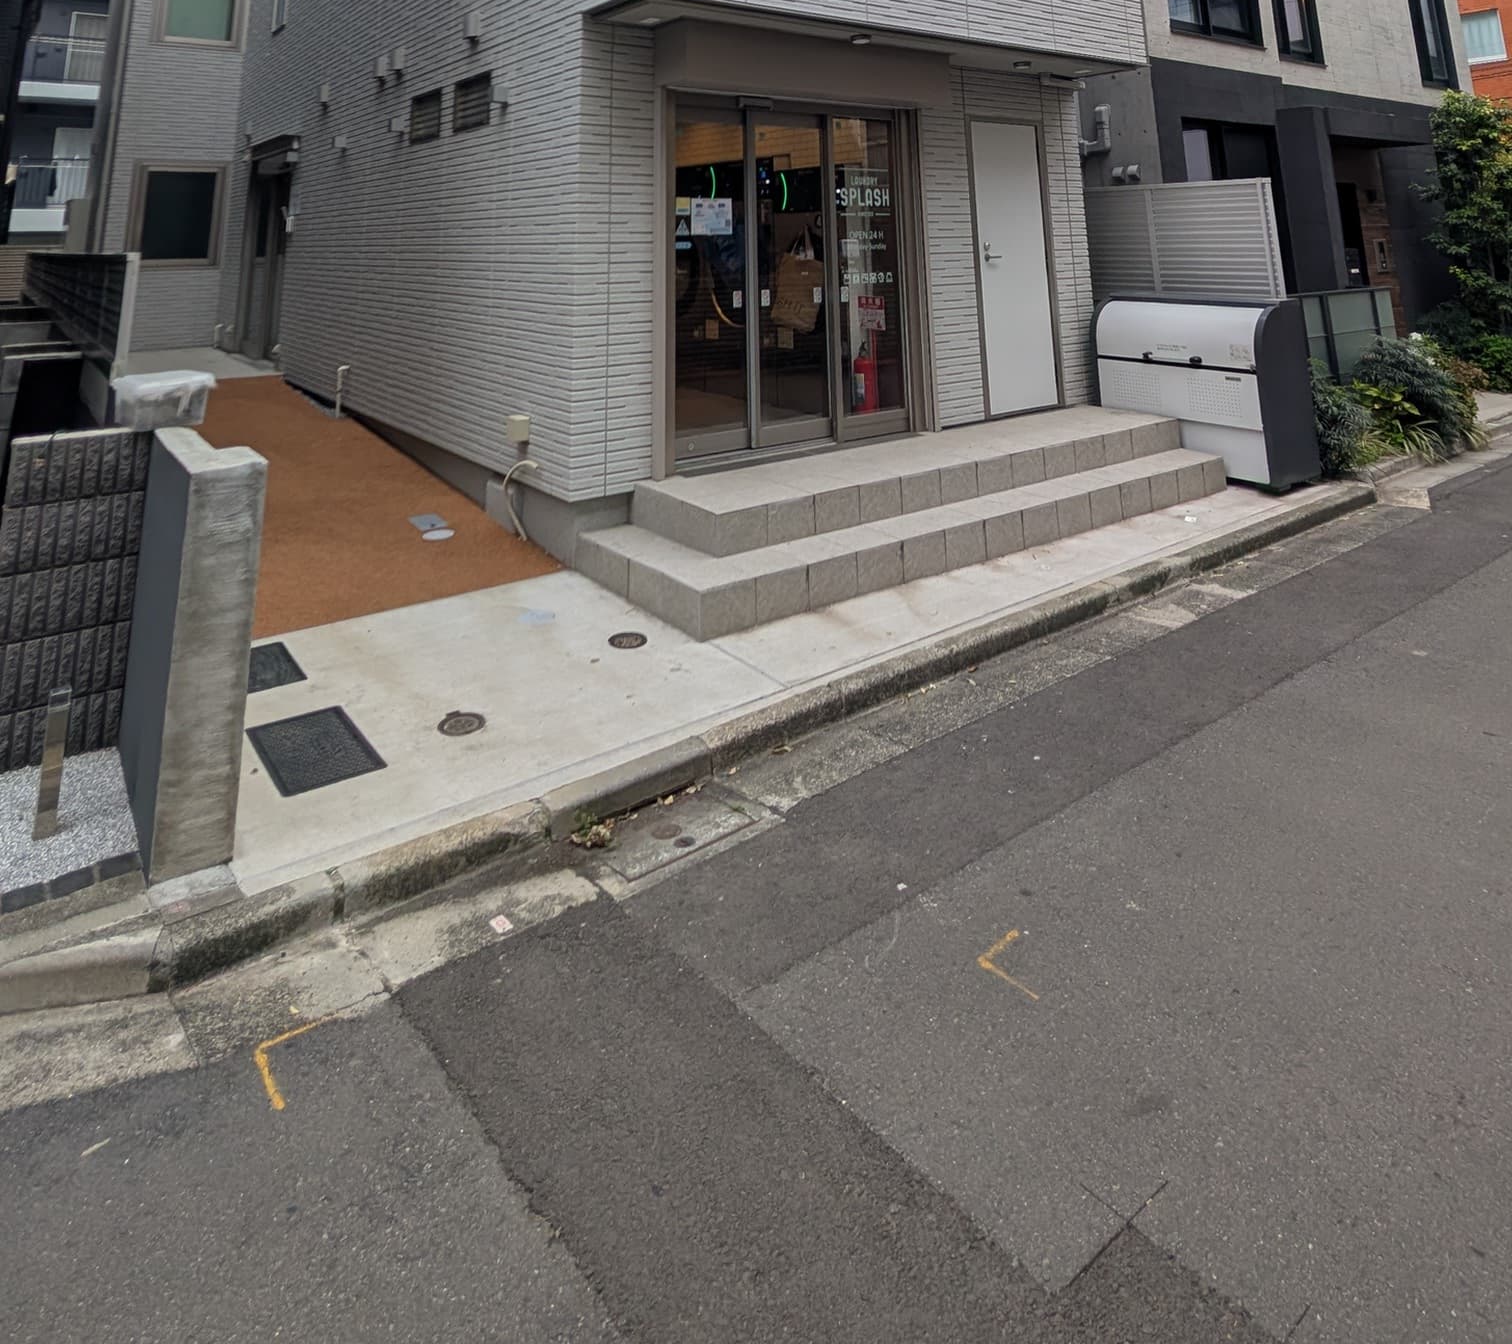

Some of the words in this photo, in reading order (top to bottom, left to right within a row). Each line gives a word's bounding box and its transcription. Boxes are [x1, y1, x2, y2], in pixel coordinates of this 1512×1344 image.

[840, 187, 890, 207] SPLASH
[849, 230, 869, 240] OPEN
[869, 231, 878, 240] 24
